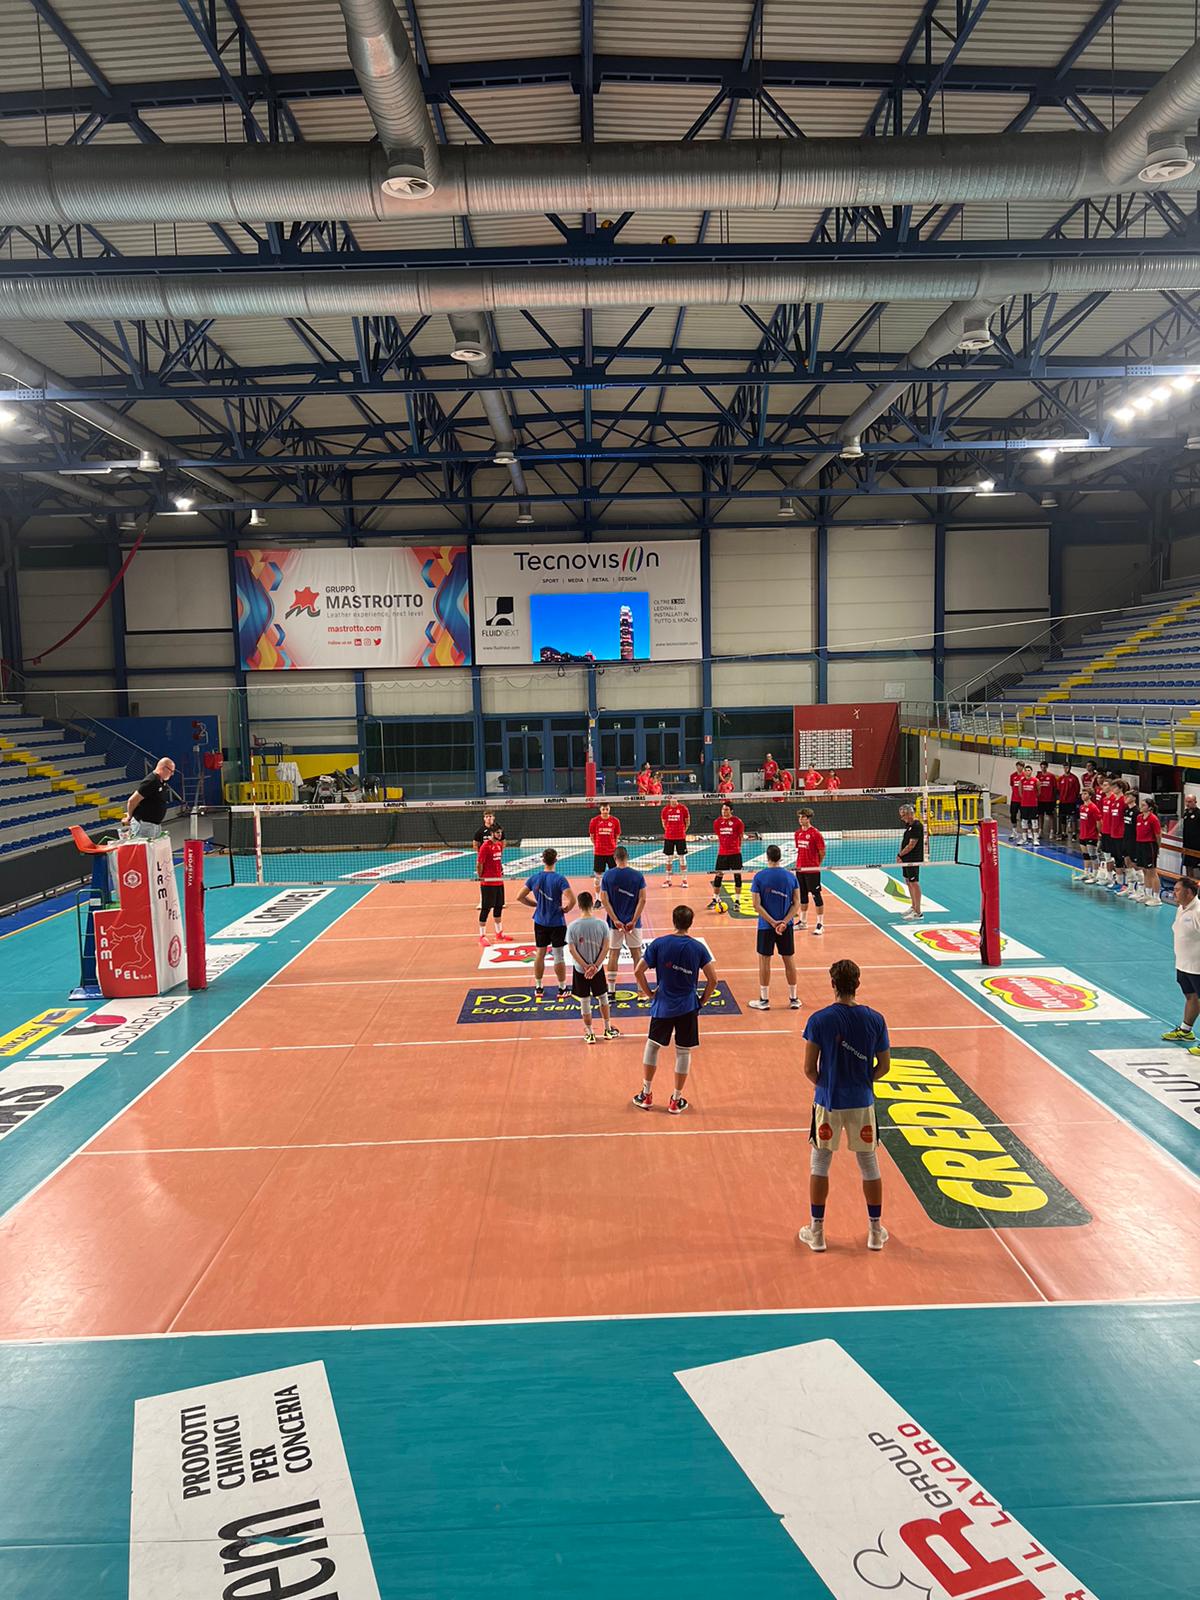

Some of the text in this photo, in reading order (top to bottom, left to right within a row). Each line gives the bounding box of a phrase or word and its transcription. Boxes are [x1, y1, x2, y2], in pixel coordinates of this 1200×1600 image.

[325, 585, 356, 593] GRUPPO
[326, 594, 424, 609] MASTROTTO
[326, 611, 351, 619] Leather
[327, 625, 382, 633] mastrotto.com
[481, 629, 519, 637] FLUIDNEXT
[156, 861, 179, 921] LAMIPEL
[243, 889, 328, 924] LAMIPEL
[100, 925, 140, 981] LAMIPEL
[100, 998, 185, 1047] SCIARADA
[471, 1006, 539, 1015] Express
[873, 1056, 1049, 1212] CREDEM
[180, 1404, 211, 1500] PRODOTTI
[213, 1415, 246, 1490] CHIMICI
[274, 1384, 313, 1474] CONCERIA
[249, 1444, 280, 1483] PER
[868, 1431, 953, 1508] GROUP
[897, 1423, 1058, 1573] IL LAVORO
[218, 1499, 339, 1600] em
